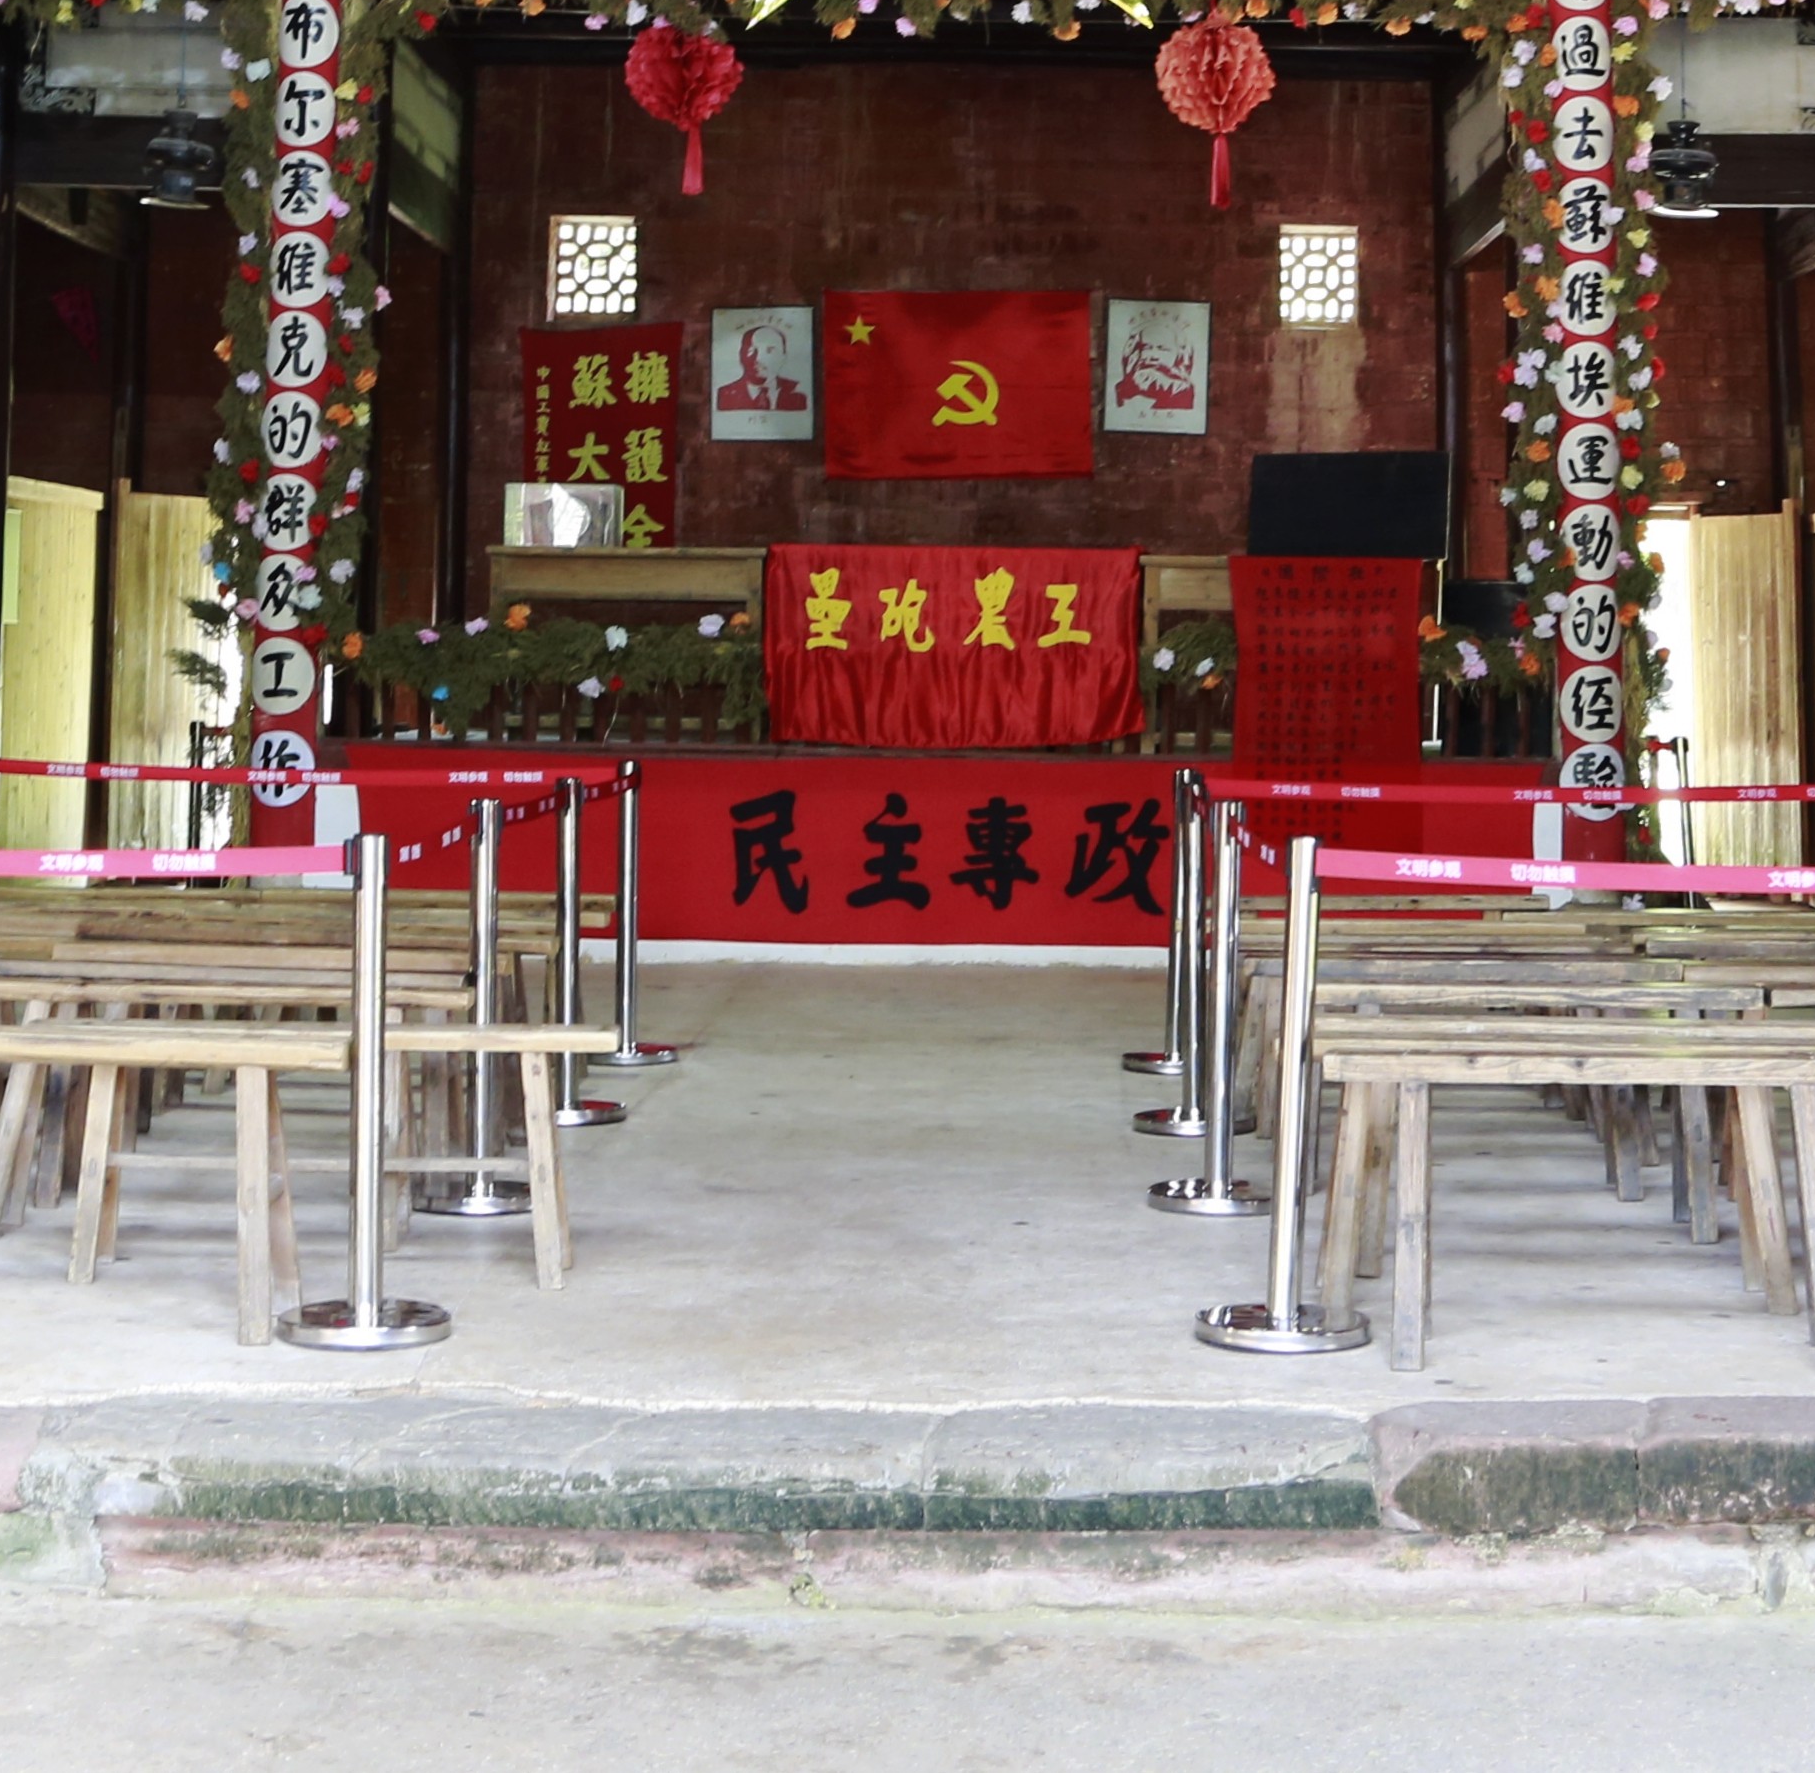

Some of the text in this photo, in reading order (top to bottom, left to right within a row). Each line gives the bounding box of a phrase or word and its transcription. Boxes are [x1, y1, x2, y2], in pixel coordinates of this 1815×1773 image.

[152, 853, 217, 873] 切勿触摸
[729, 789, 1171, 916] 民主專政
[39, 854, 104, 873] 文明参观
[1395, 858, 1461, 879] 文明参观
[1510, 863, 1576, 884] 切勿触摸
